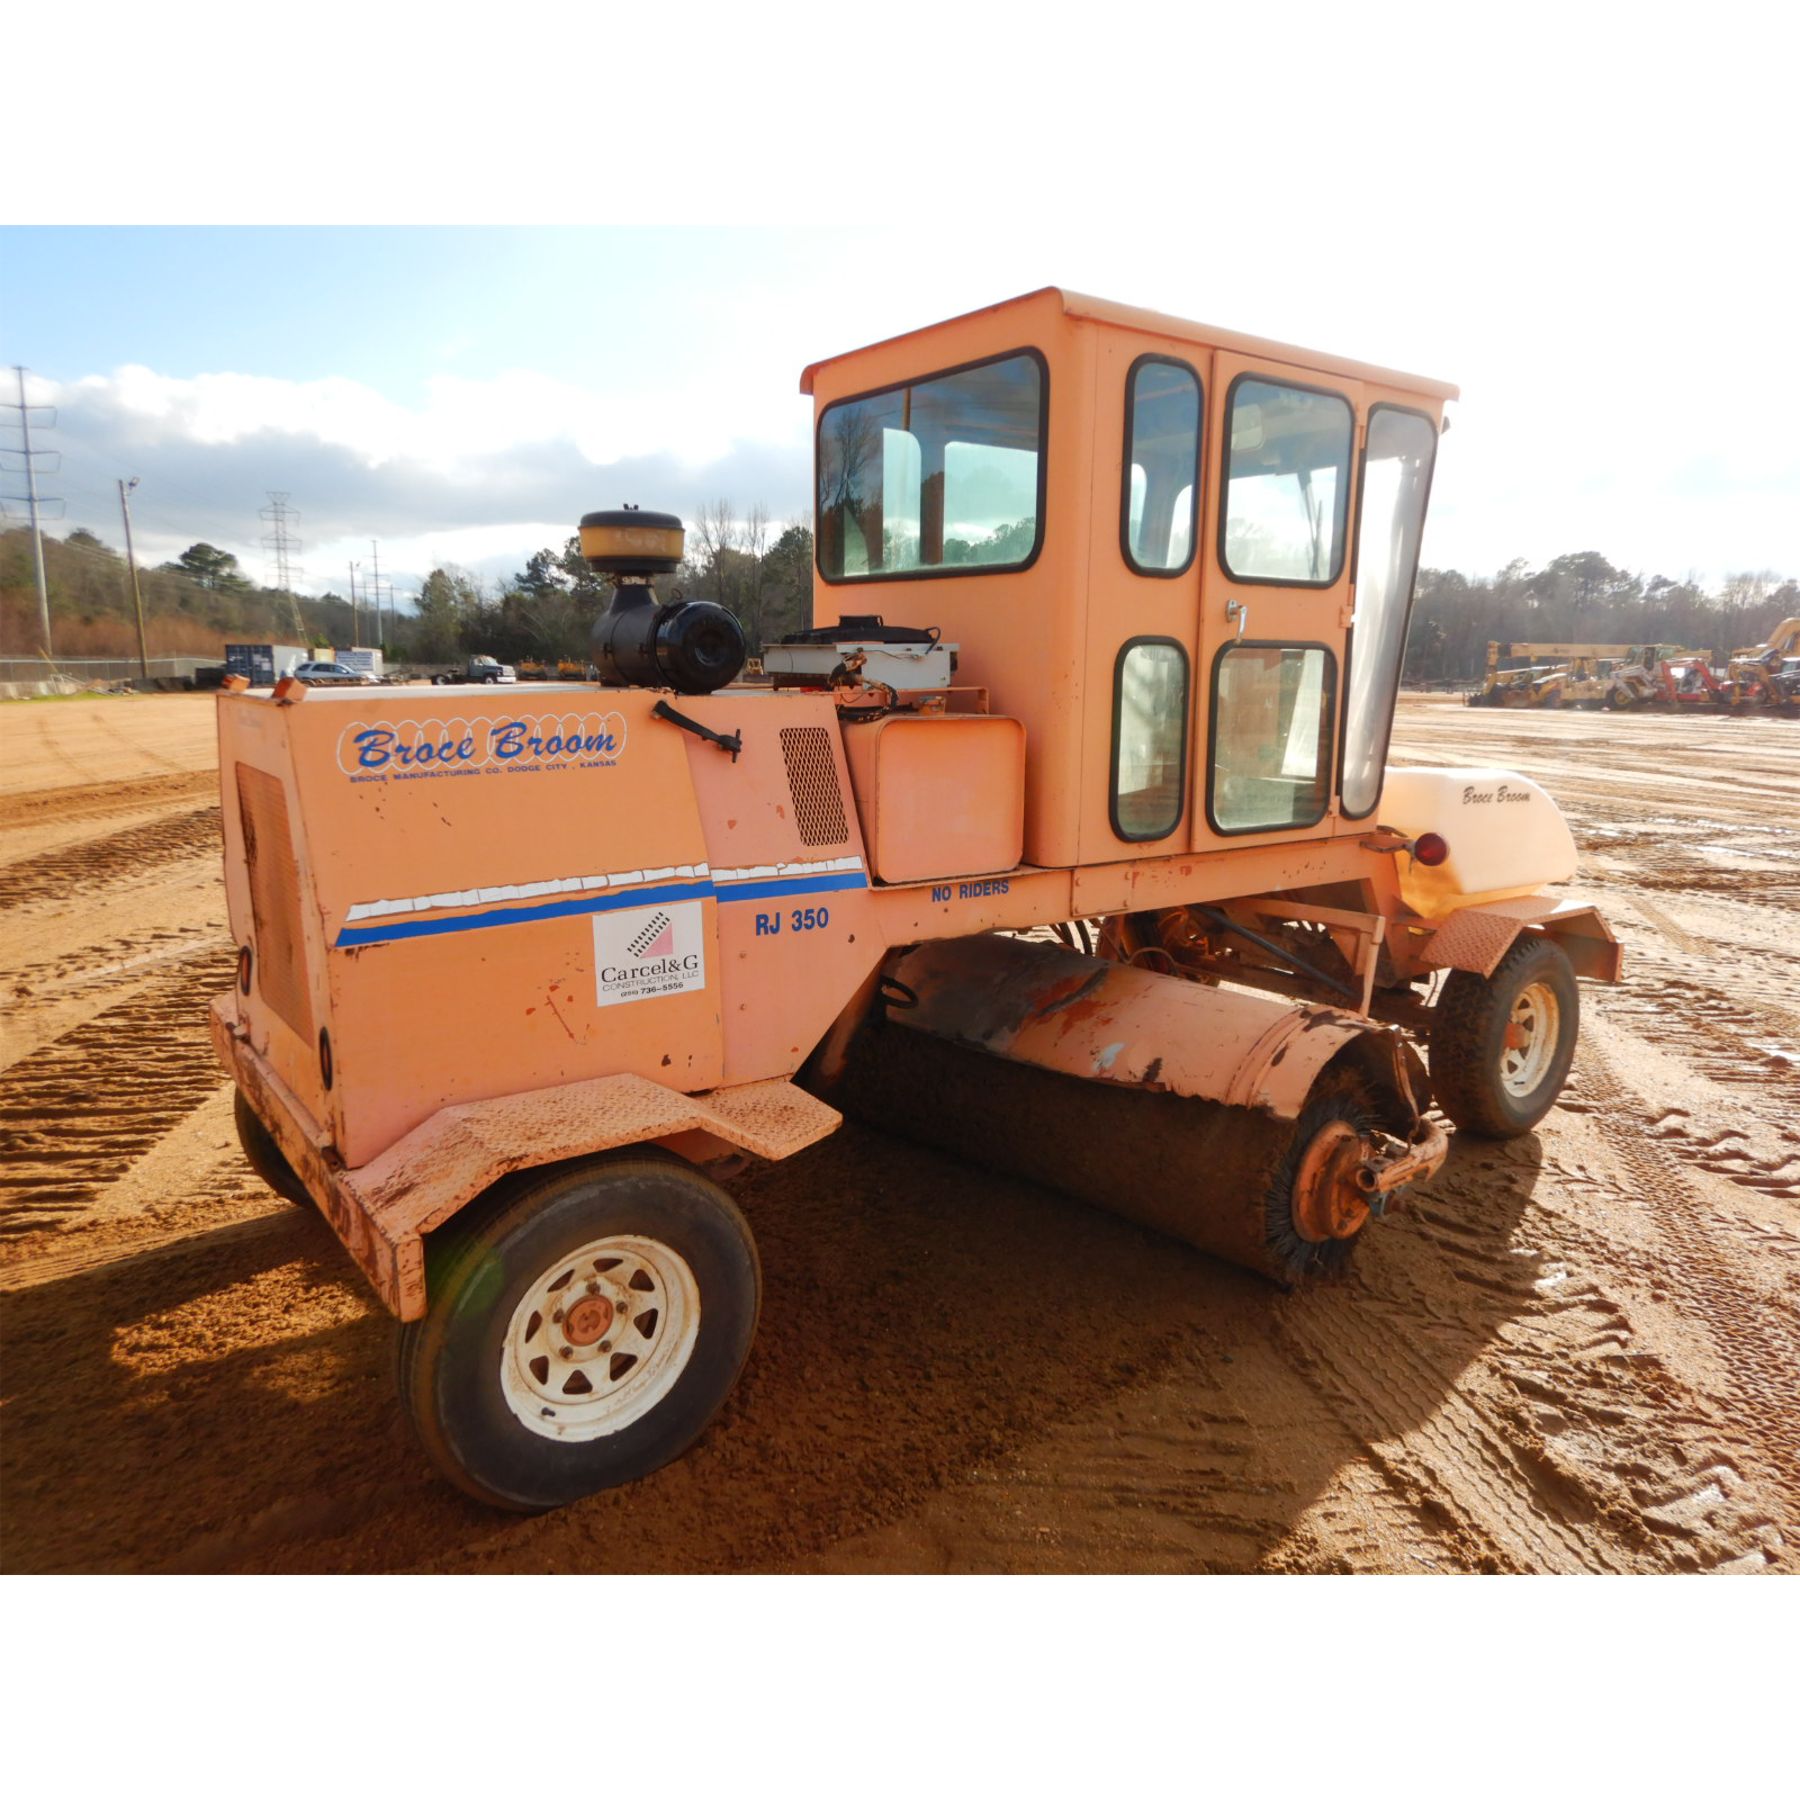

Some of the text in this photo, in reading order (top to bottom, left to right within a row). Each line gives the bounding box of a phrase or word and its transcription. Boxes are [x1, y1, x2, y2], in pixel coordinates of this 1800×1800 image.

[353, 721, 617, 768] Broce Broom
[350, 774, 388, 783] BROCE
[393, 768, 481, 781] MANUFACTURING
[507, 764, 542, 773] DODGE
[579, 760, 617, 769] KANSAS
[931, 879, 1010, 902] NO RIDERS
[755, 907, 829, 936] RJ 350
[601, 955, 698, 983] Carcel&G
[682, 970, 700, 980] LLC
